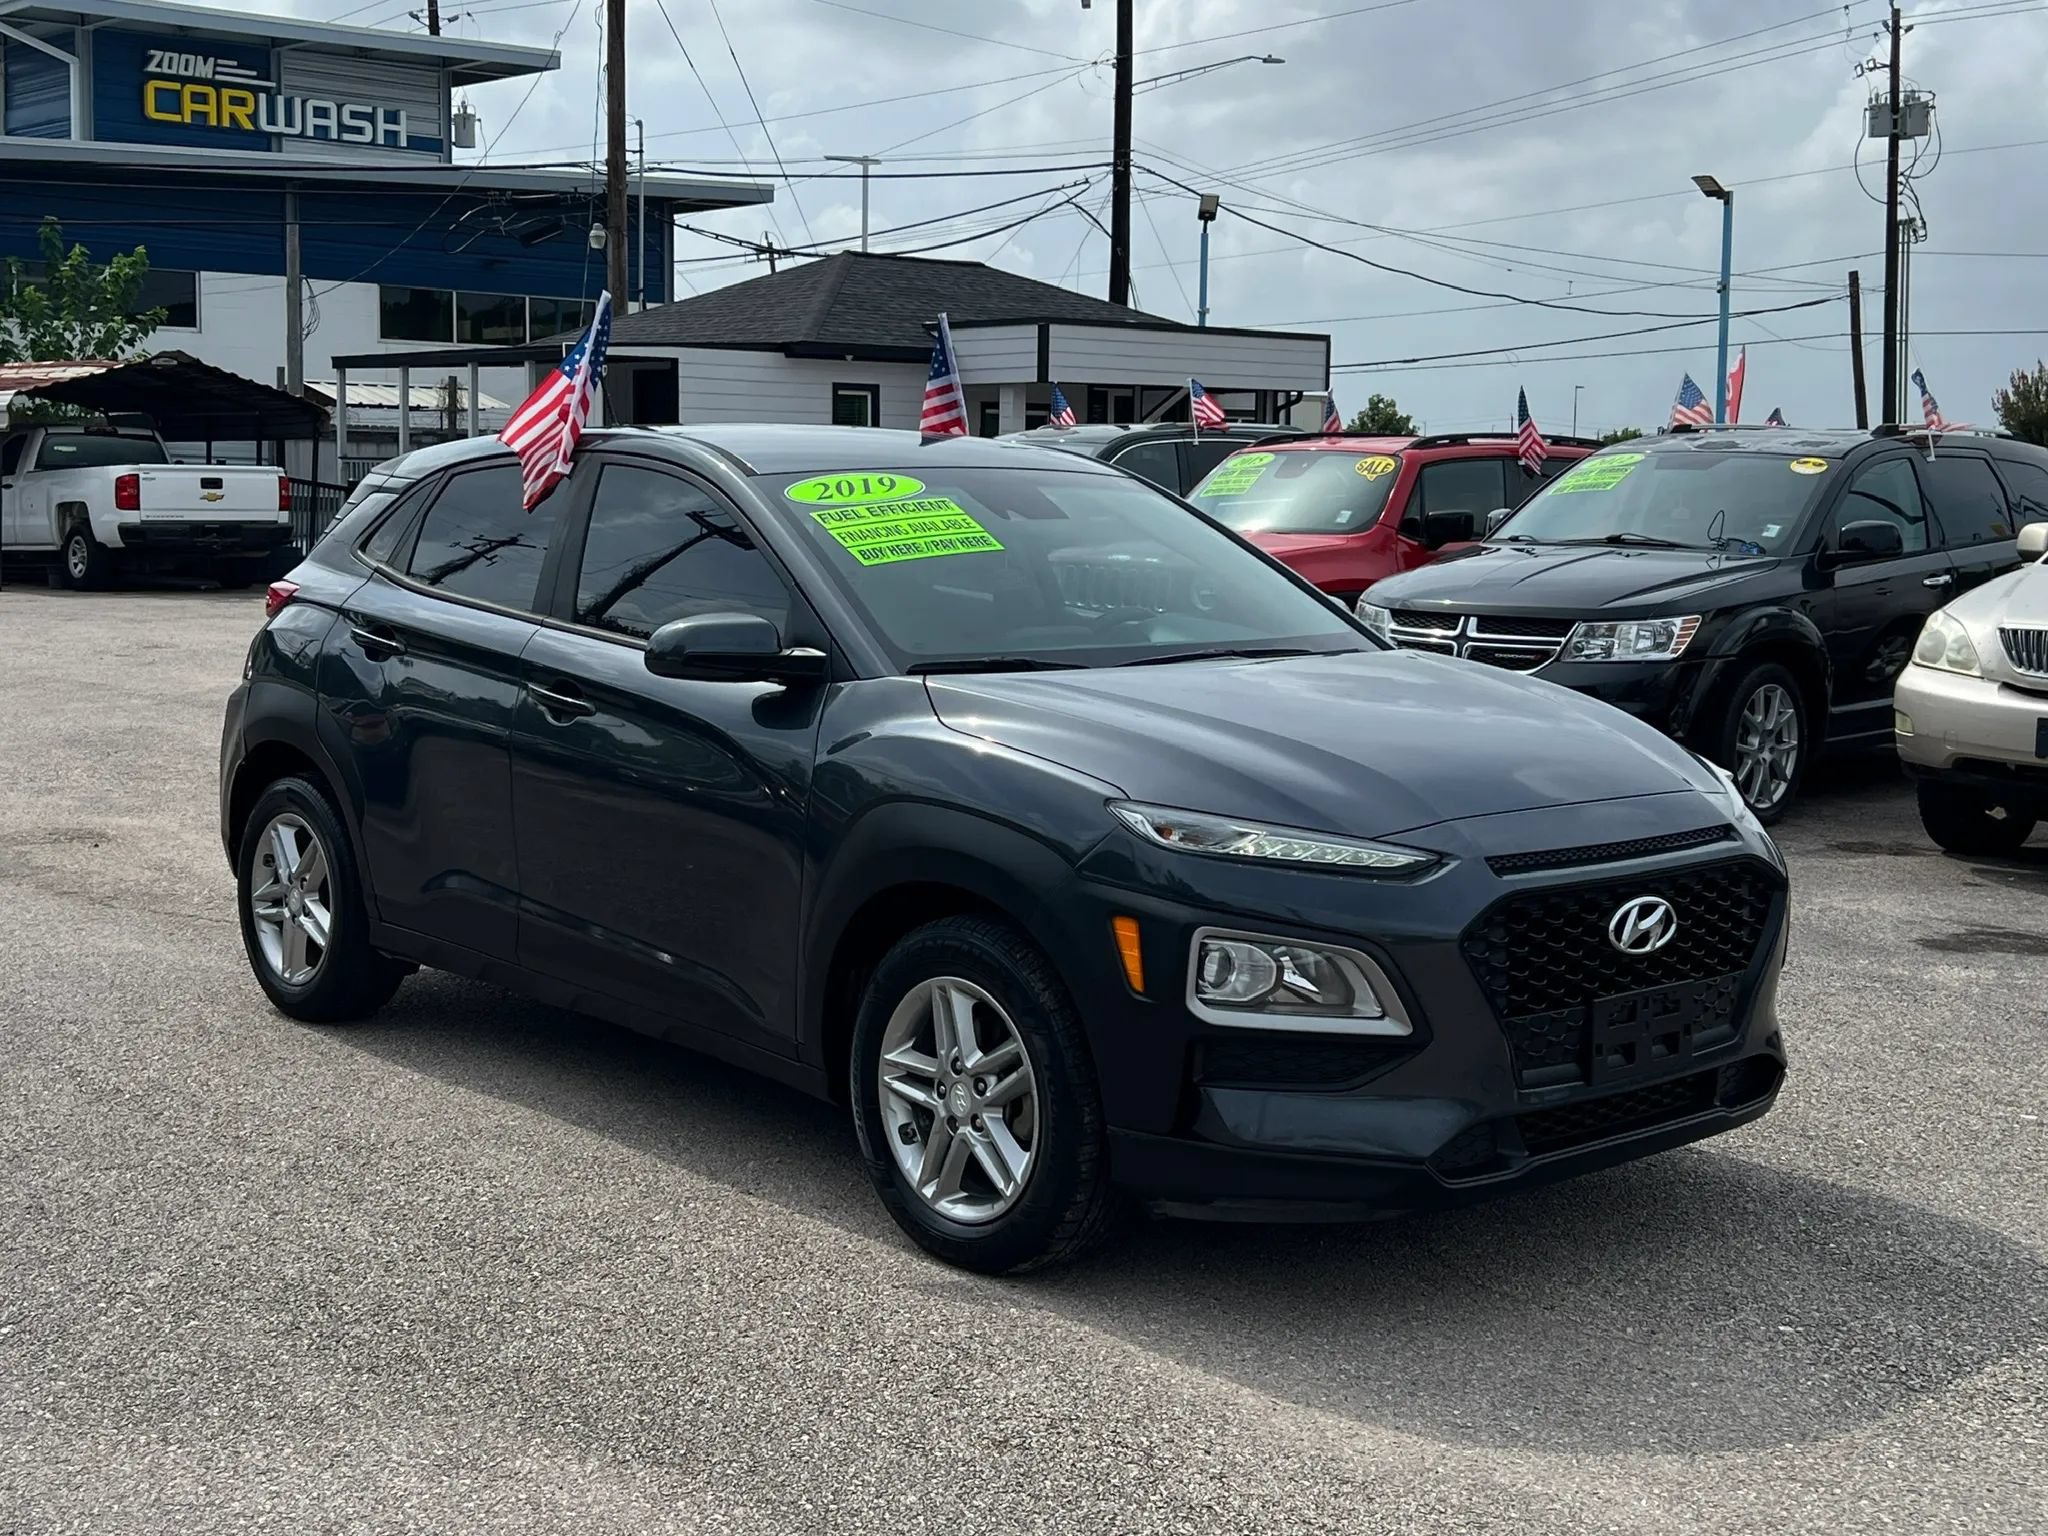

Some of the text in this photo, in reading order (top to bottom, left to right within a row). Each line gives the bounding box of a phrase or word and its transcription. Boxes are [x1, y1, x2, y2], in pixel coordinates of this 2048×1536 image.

[145, 50, 215, 79] ZOOM
[1356, 460, 1393, 475] SALE
[812, 476, 897, 500] 2019
[817, 500, 953, 524] FUEL EFFICIENT
[836, 519, 976, 543] FINANCING AVAILABLE
[858, 546, 886, 560] BUY
[886, 542, 922, 556] HERE
[930, 538, 956, 550] PAY
[956, 535, 993, 547] HERE
